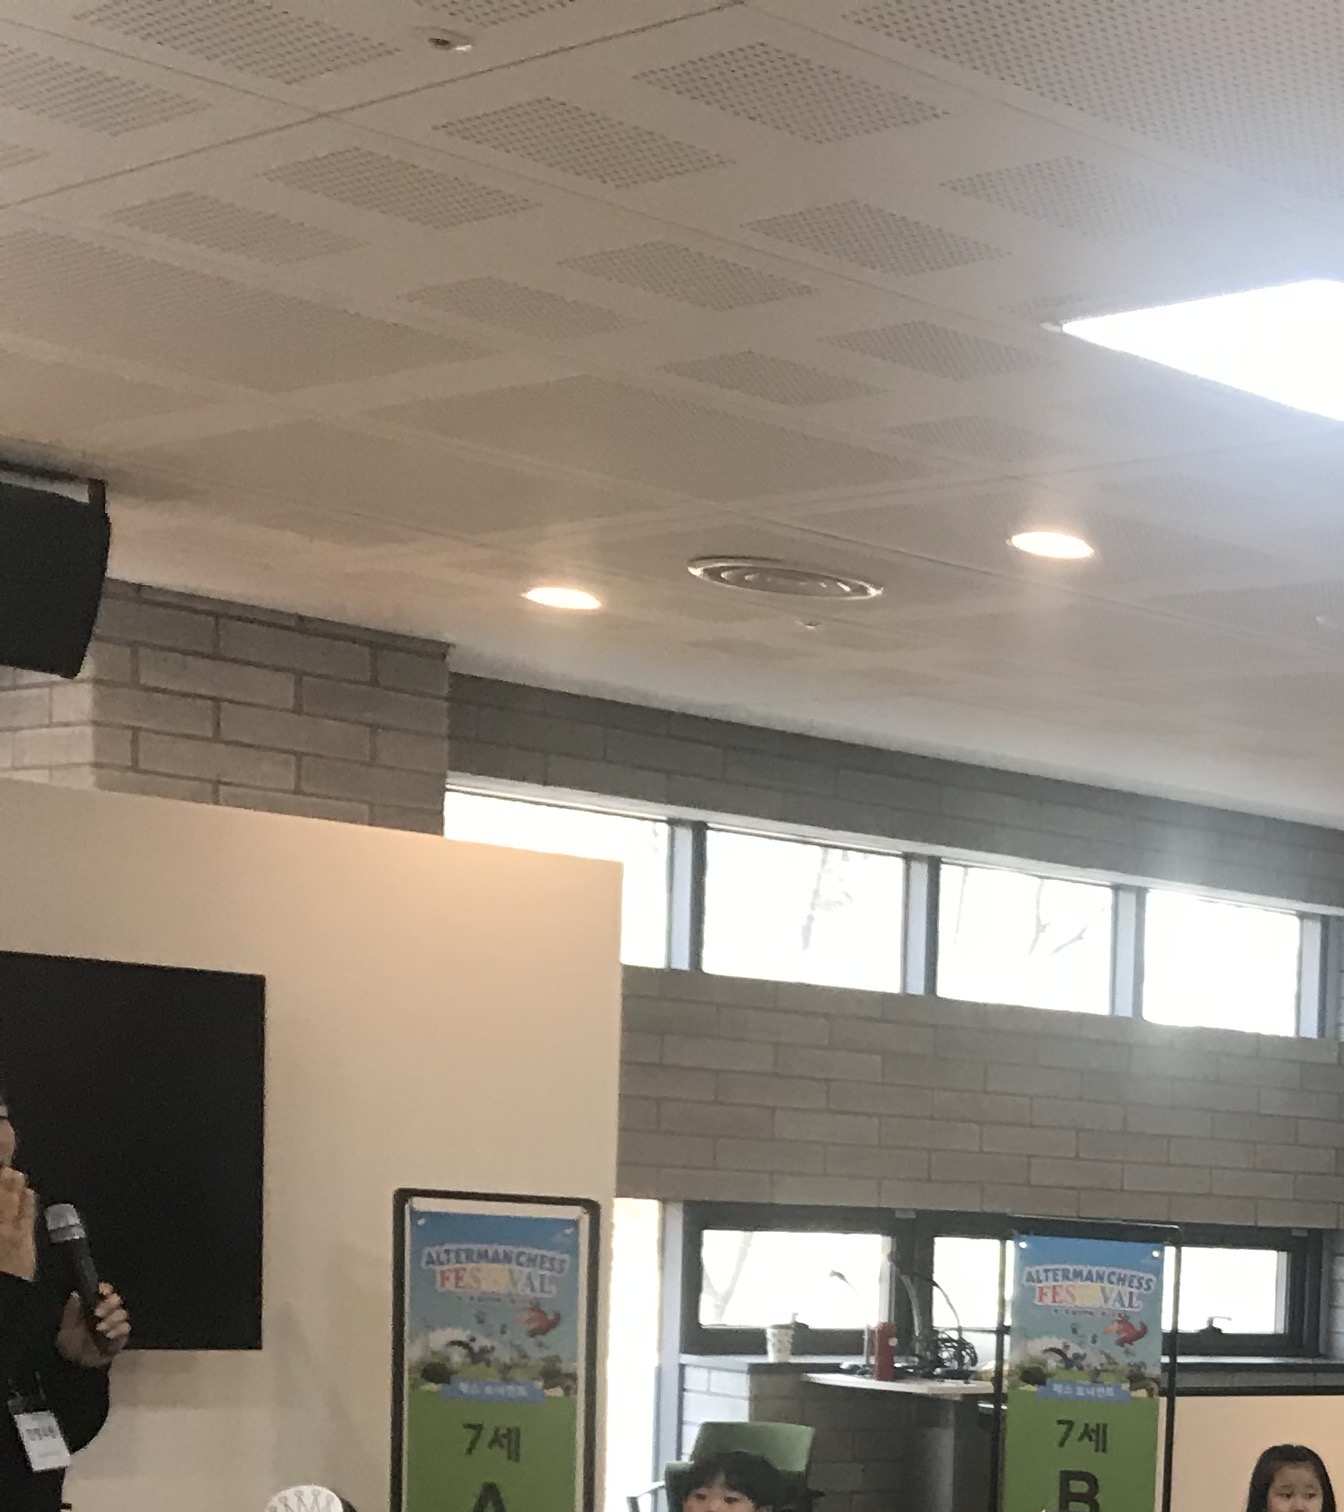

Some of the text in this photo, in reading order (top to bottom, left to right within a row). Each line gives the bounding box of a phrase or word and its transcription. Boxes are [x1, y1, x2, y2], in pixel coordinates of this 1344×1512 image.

[439, 1267, 552, 1294] FESVAL
[1037, 1284, 1140, 1309] FESVAL
[462, 1422, 522, 1463] 7세
[1056, 1418, 1108, 1454] 7세
